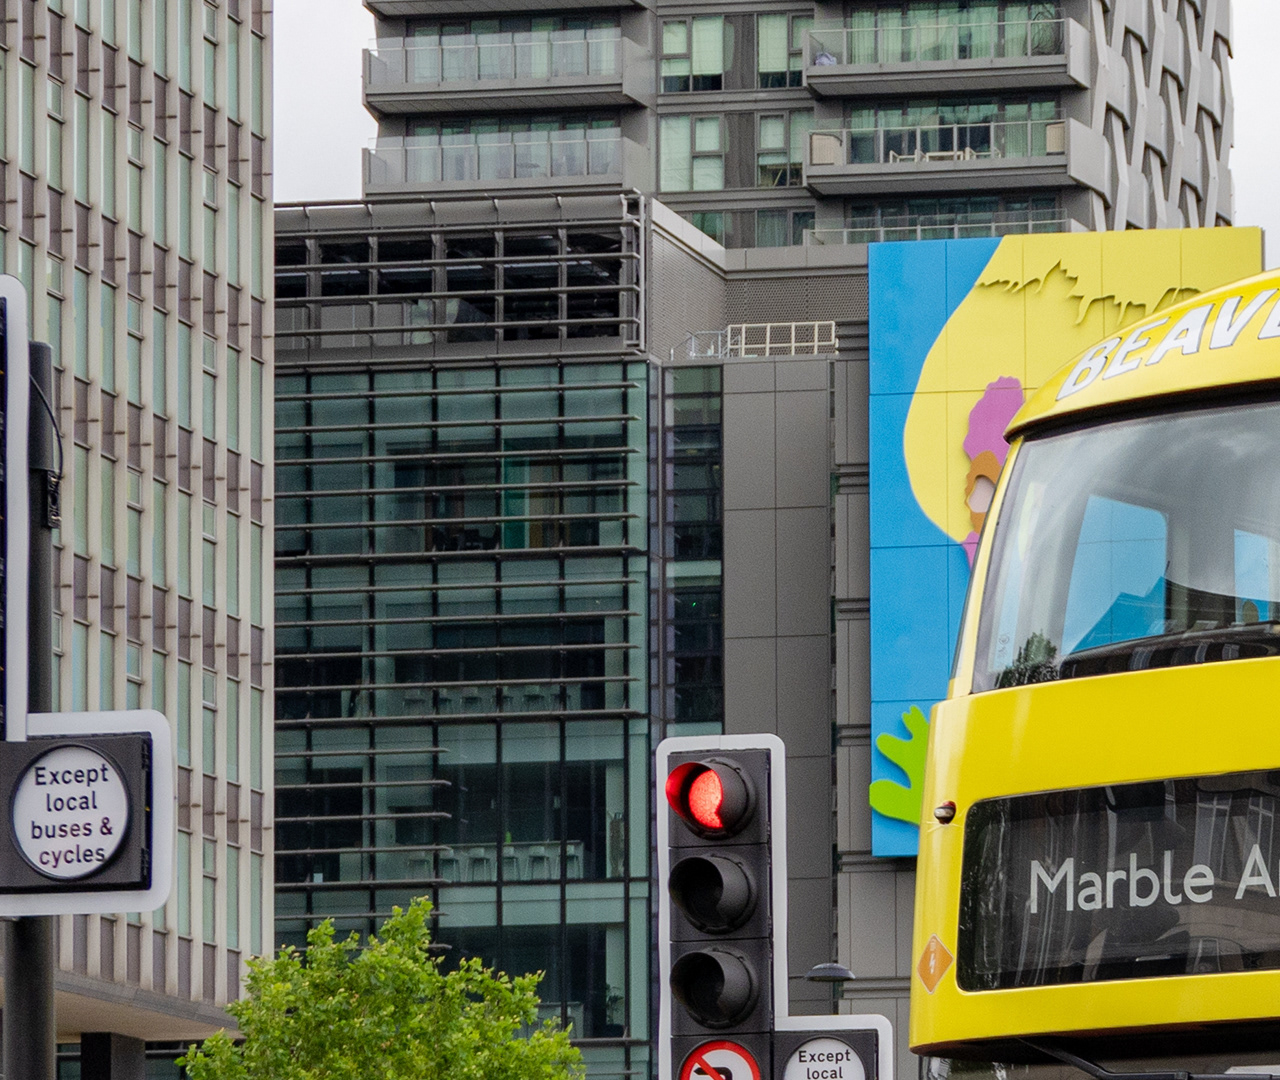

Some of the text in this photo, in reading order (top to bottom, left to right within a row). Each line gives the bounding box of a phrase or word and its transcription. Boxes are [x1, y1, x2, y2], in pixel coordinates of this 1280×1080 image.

[34, 763, 109, 787] Except
[46, 790, 98, 812] local
[31, 816, 113, 839] buses &
[39, 844, 106, 869] cycles
[1029, 850, 1215, 914] Marble
[798, 1049, 851, 1064] Except
[806, 1066, 844, 1080] local
